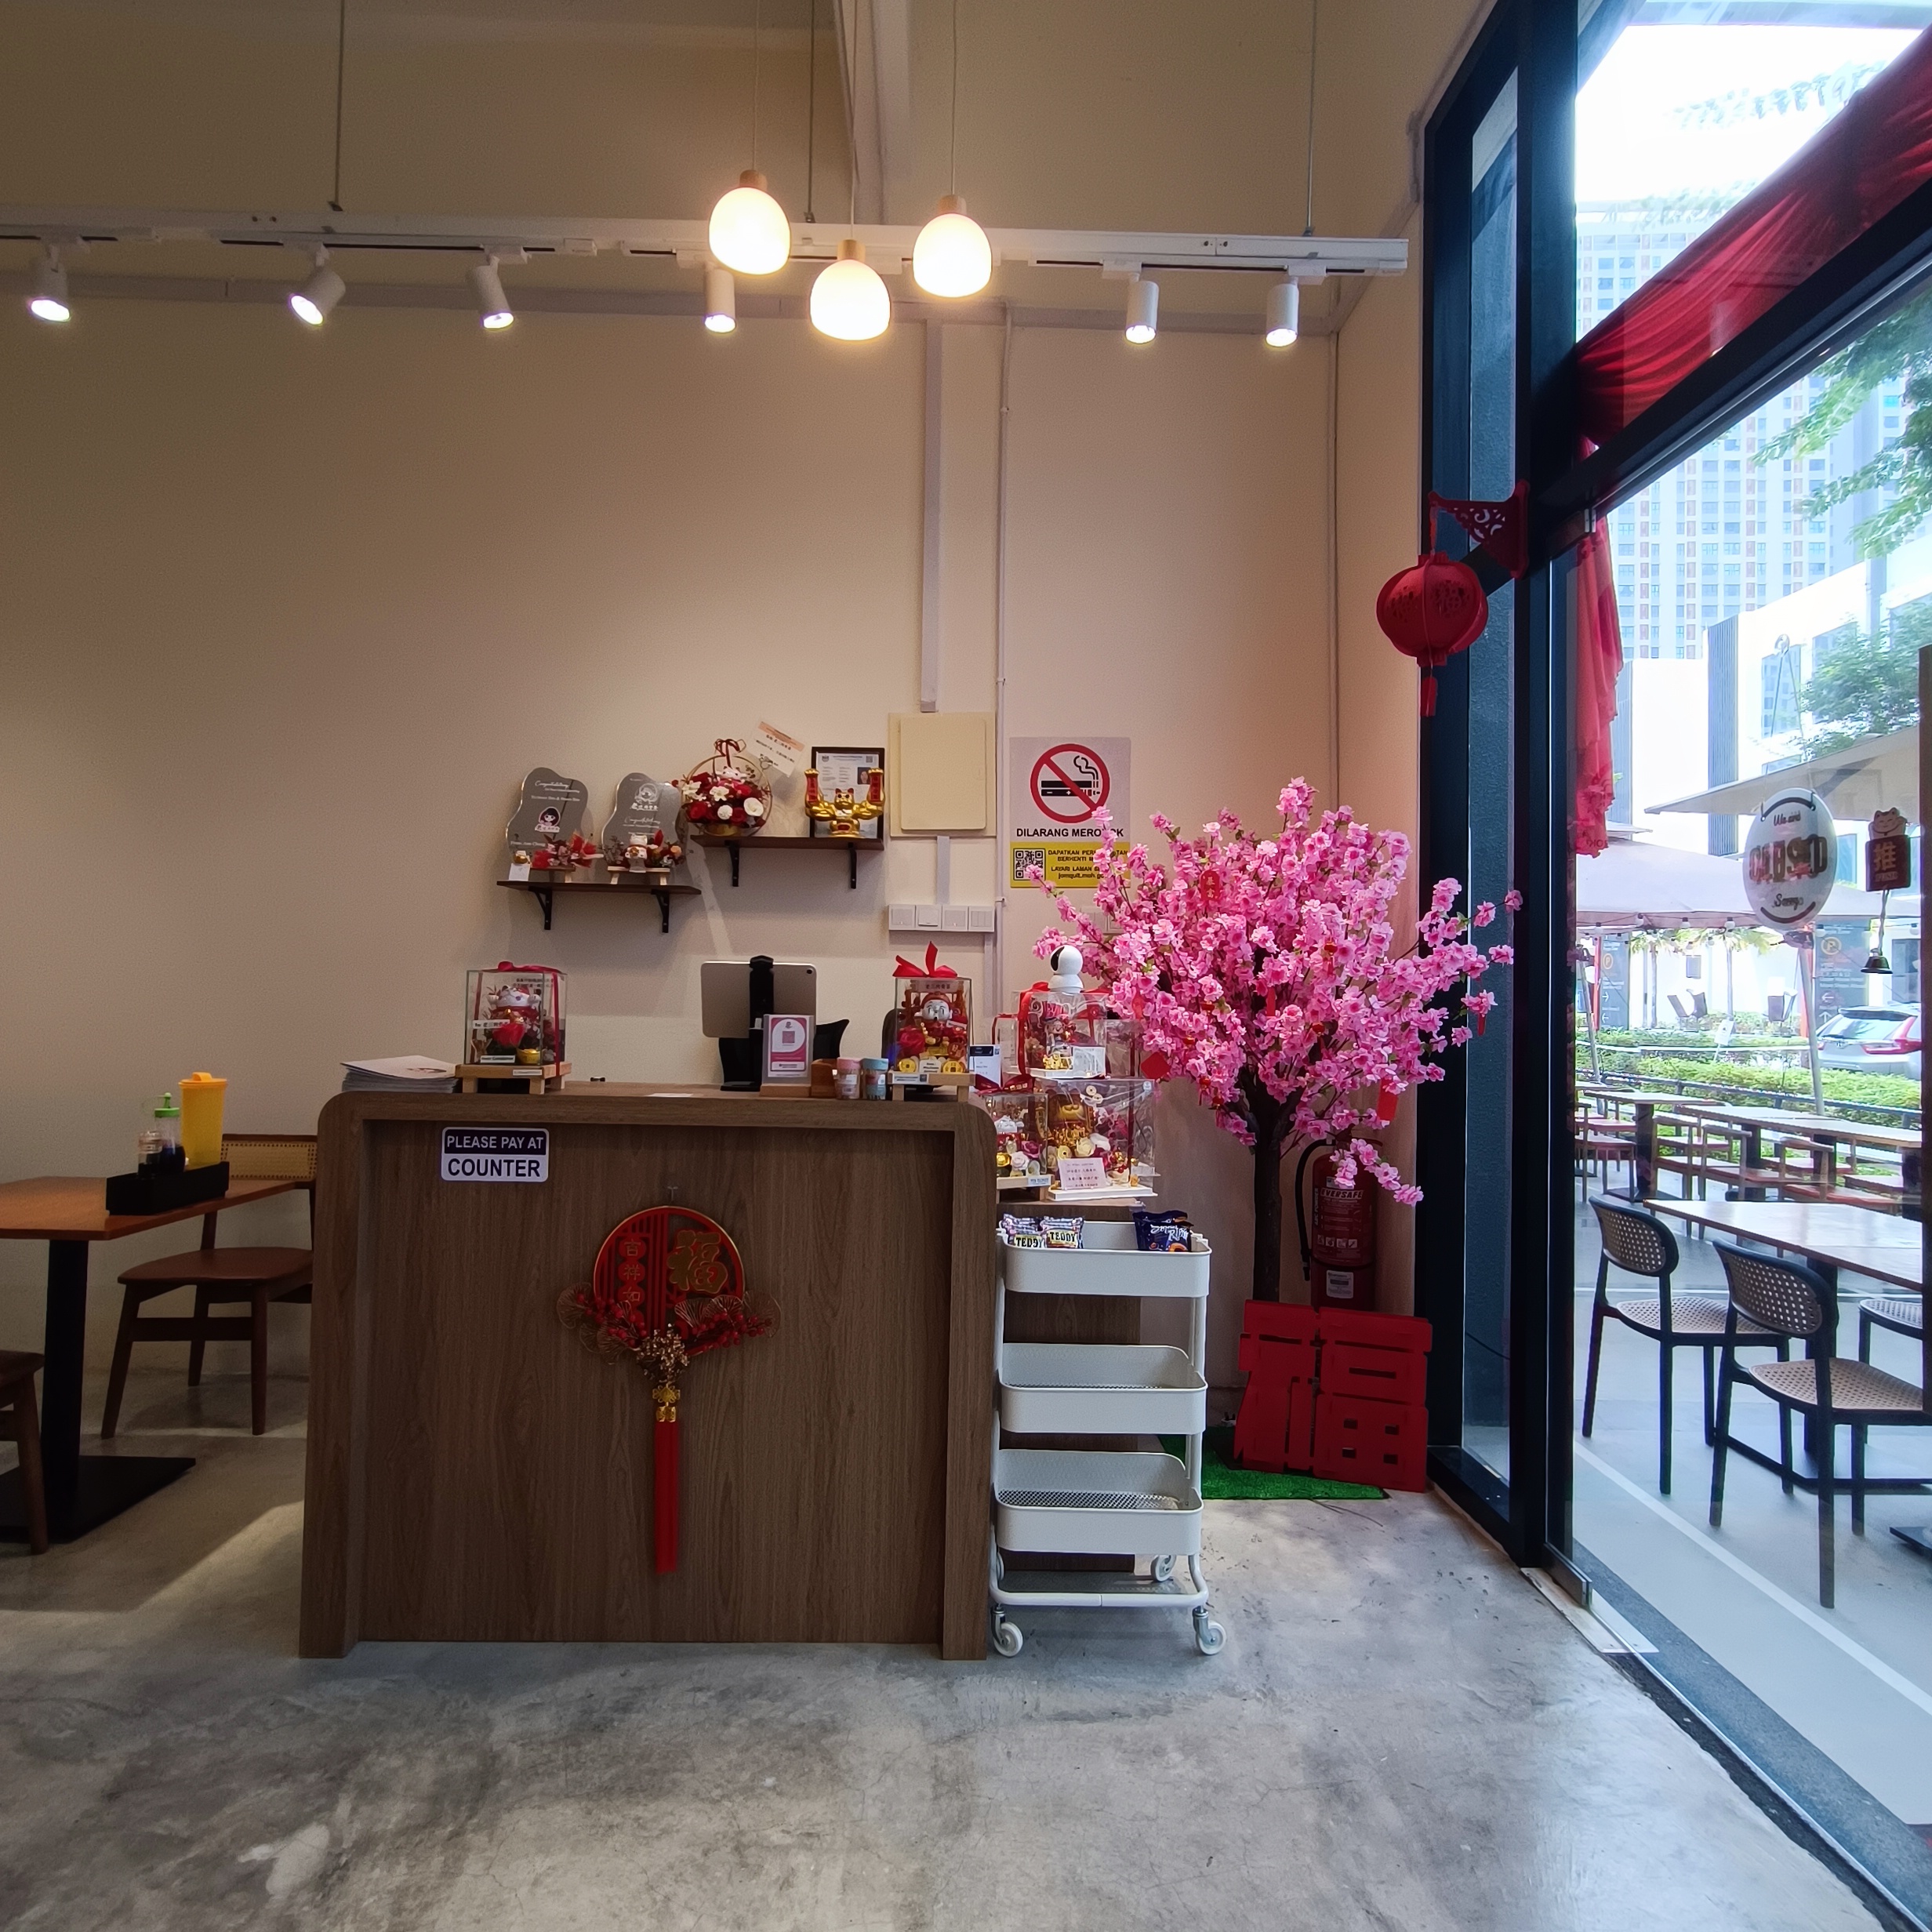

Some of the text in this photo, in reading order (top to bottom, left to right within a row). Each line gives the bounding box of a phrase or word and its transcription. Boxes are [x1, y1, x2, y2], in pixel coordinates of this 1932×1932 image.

[1016, 828, 1124, 837] DILARANG MEROK
[1873, 841, 1896, 872] 推
[447, 1135, 544, 1149] PLEASE PAY AT
[448, 1158, 540, 1177] COUNTER
[1320, 1188, 1364, 1199] EVERSAFE
[1015, 1237, 1044, 1248] TEDDY
[1049, 1232, 1077, 1243] TEDDY
[666, 1229, 728, 1294] 福
